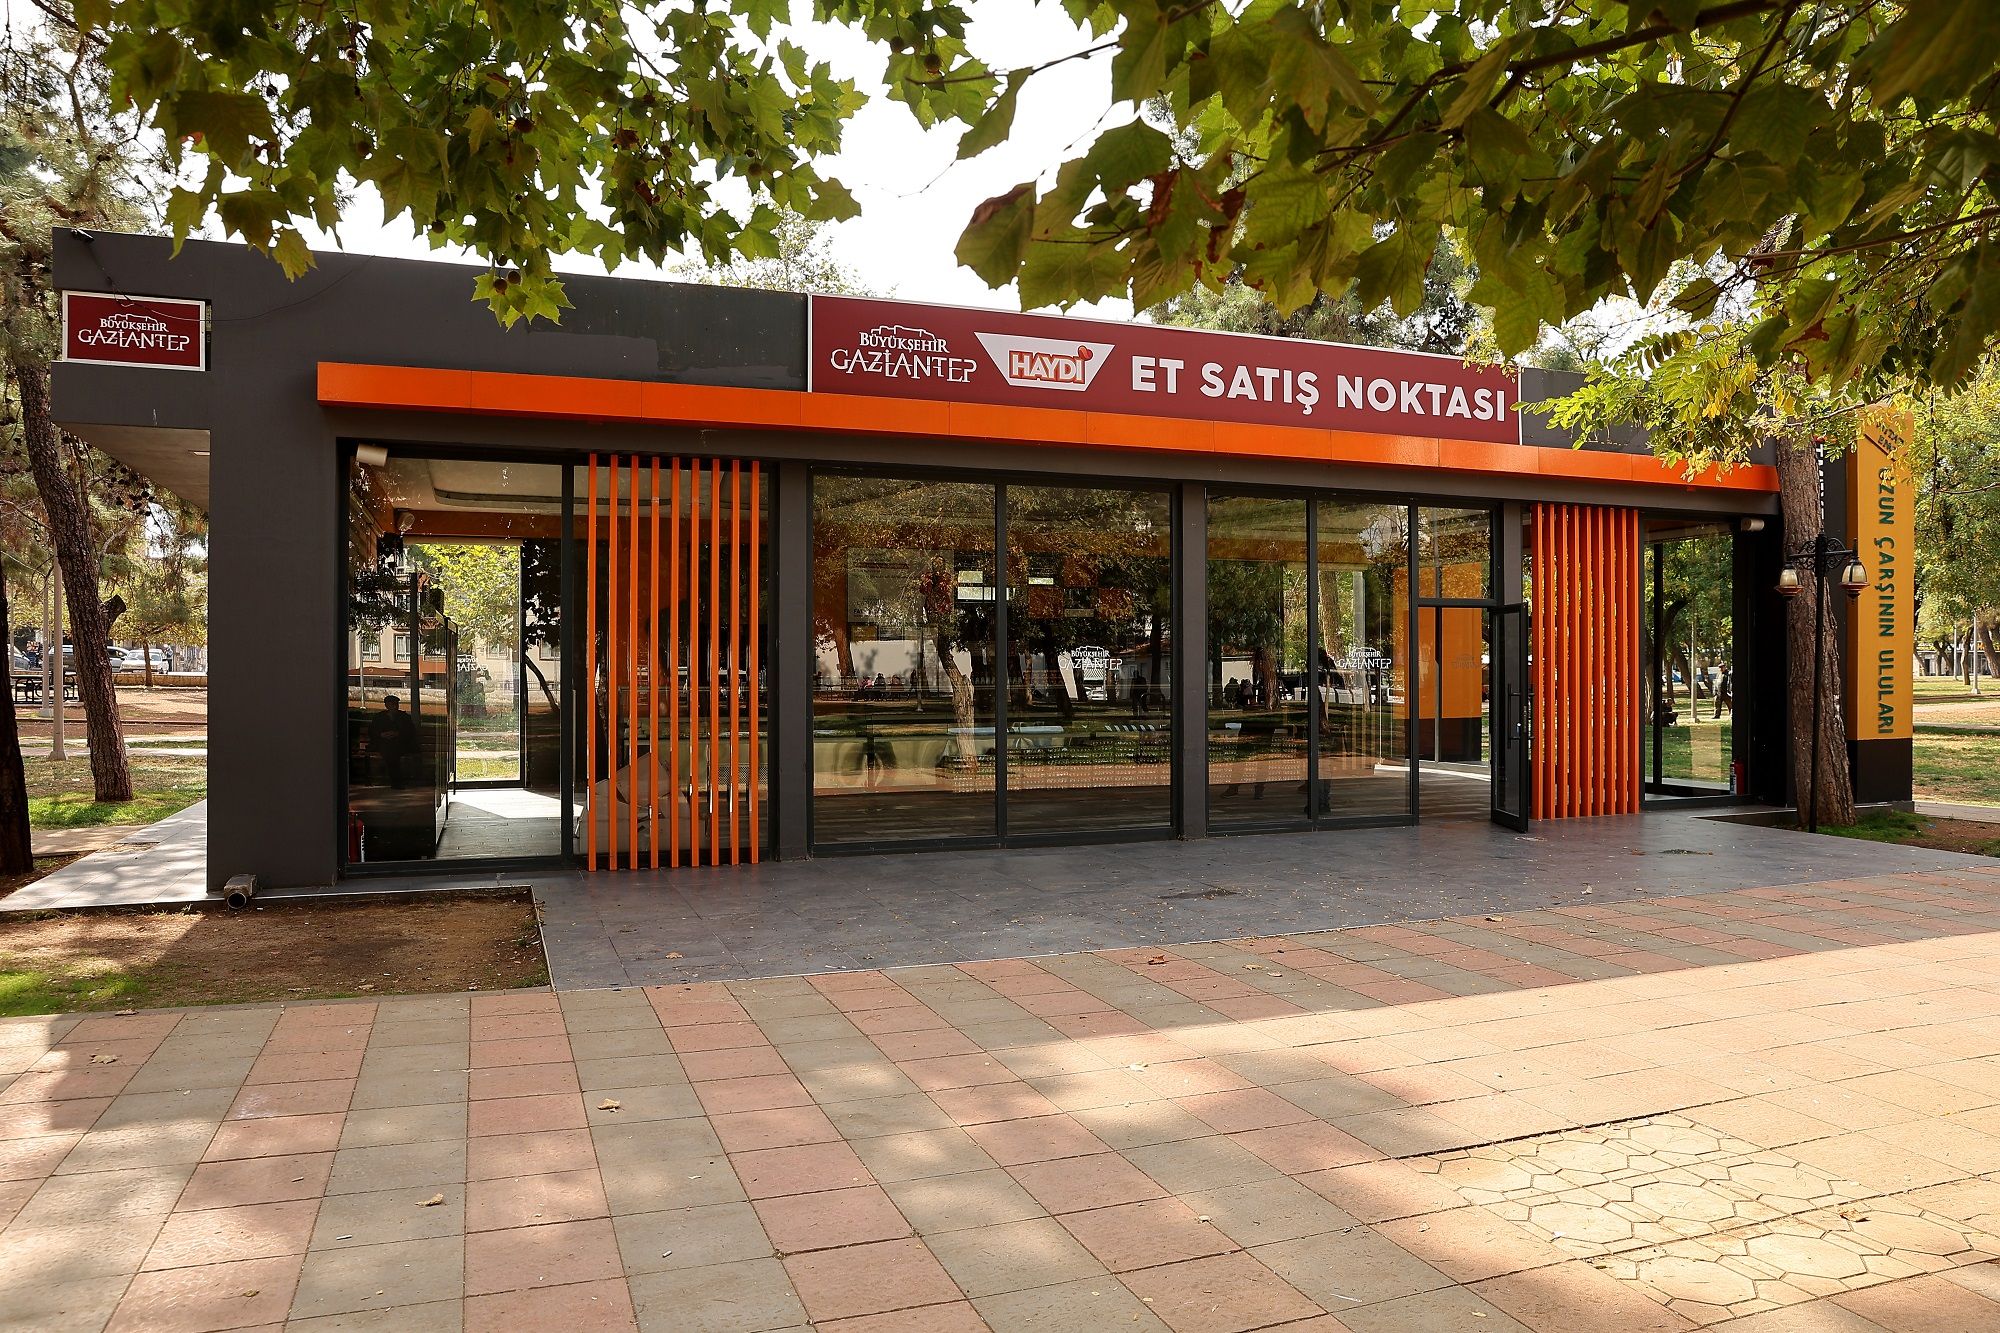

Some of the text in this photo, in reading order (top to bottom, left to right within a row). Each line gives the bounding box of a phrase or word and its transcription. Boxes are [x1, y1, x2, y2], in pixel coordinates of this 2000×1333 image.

[830, 348, 978, 383] GAZİANTEP
[859, 331, 950, 354] BÜYÜKŞEHİR
[1131, 355, 1505, 422] ET SATIŞ NOKTASI
[1874, 536, 1895, 637] ÇARŞININ
[1877, 649, 1895, 734] ULULARI
